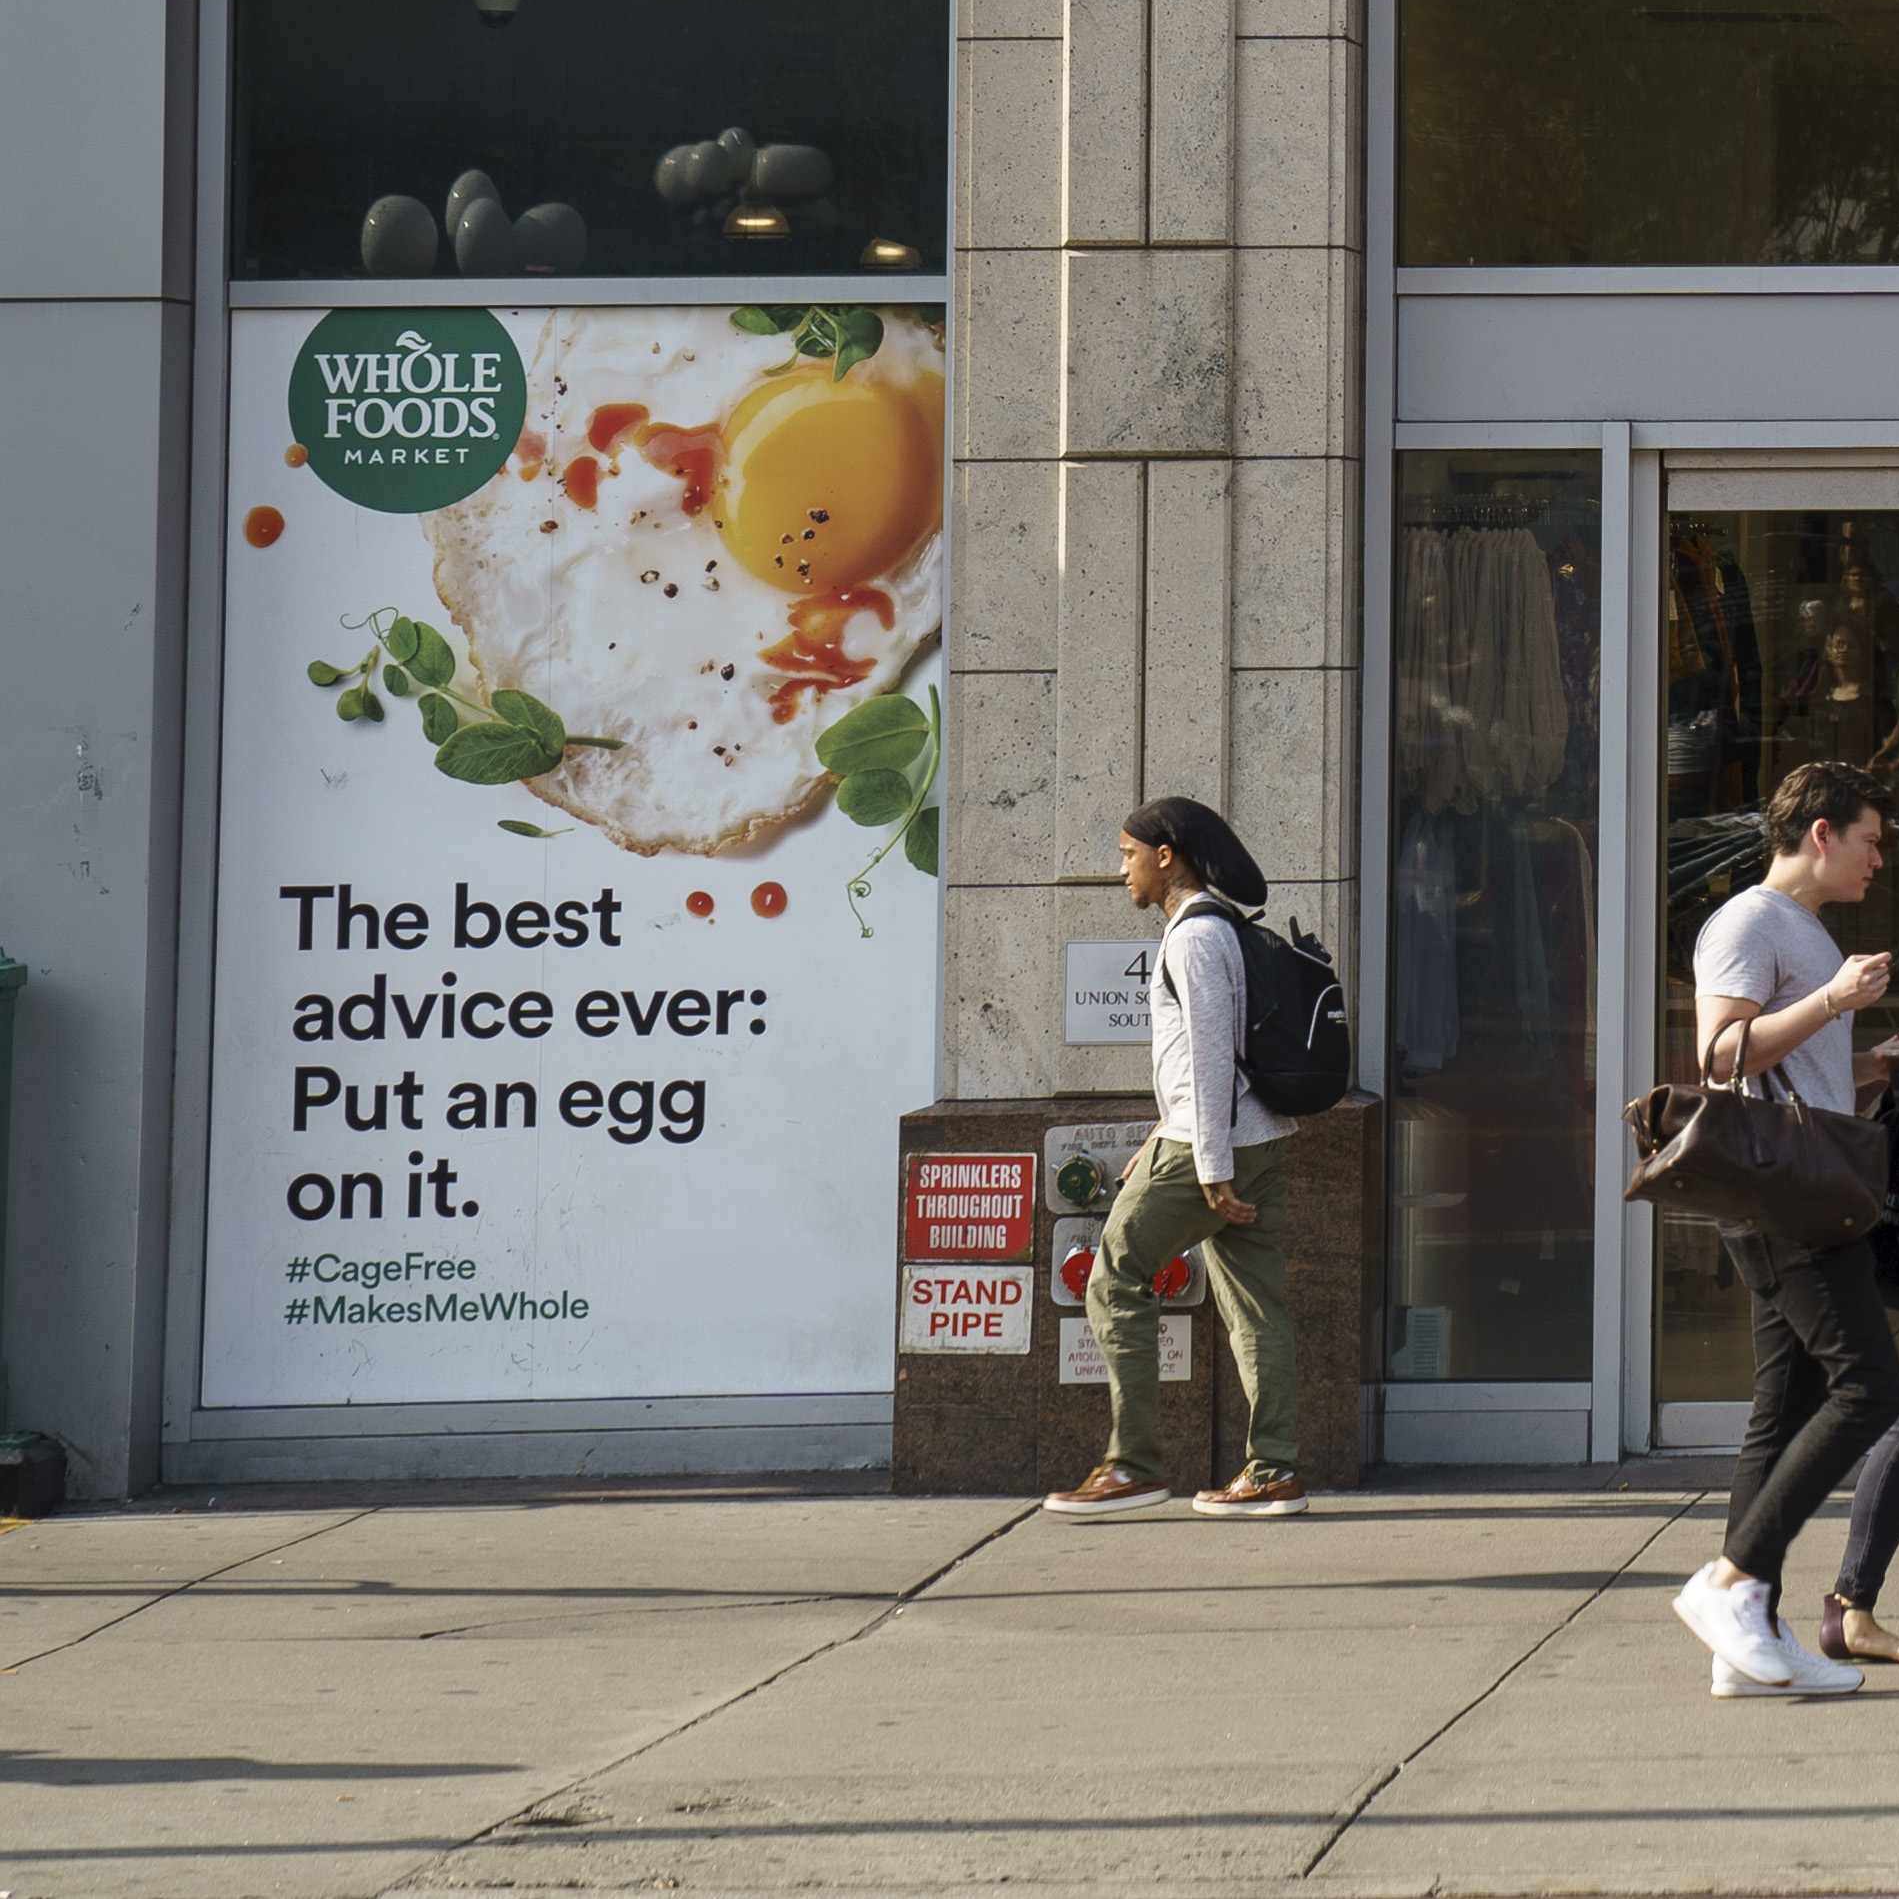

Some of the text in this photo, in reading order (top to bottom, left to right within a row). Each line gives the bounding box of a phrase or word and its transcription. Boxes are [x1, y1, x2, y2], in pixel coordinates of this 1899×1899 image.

[314, 346, 502, 393] WHOLE
[324, 398, 496, 439] FOODS
[344, 448, 469, 465] MARKET
[280, 882, 622, 950] The best
[1124, 950, 1152, 985] 4
[292, 971, 767, 1041] advice ever:
[1076, 991, 1128, 1005] UNION
[1109, 1013, 1152, 1027] SOUT
[293, 1066, 706, 1144] Put an egg
[286, 1150, 479, 1221] on it.
[920, 1164, 1022, 1189] SPRINKLERS
[916, 1194, 1024, 1219] THROUGHOUT
[930, 1225, 1007, 1249] BUILDING
[285, 1253, 476, 1289] #CageFree
[912, 1279, 1023, 1305] STAND
[284, 1290, 589, 1325] #MakesMeWhole
[929, 1313, 1003, 1337] PIPE
[1068, 1353, 1105, 1362] AROU
